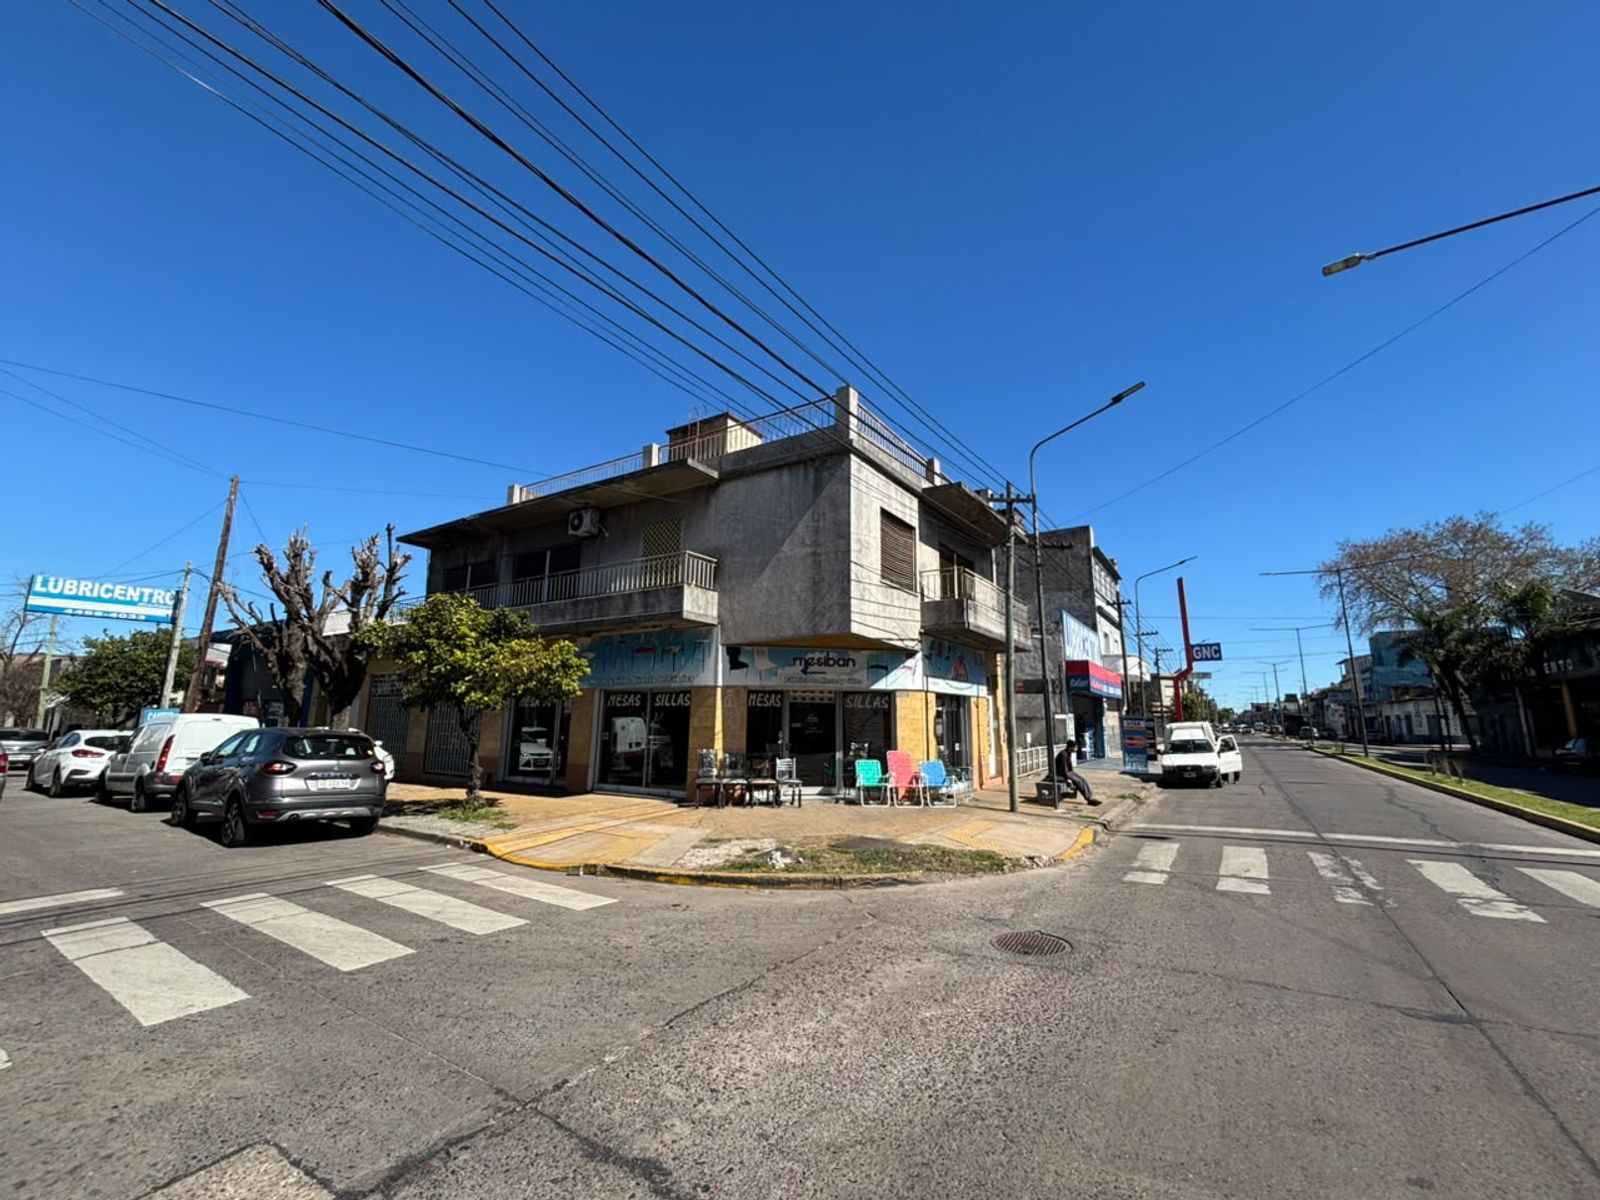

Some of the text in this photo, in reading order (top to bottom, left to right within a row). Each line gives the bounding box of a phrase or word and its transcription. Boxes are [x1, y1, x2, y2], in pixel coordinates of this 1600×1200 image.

[1192, 645, 1220, 660] GNC
[790, 651, 855, 674] mesiban
[607, 693, 642, 707] MESAS
[653, 692, 691, 707] SILLAS
[748, 692, 782, 707] MESAS
[844, 694, 889, 709] SILLAS
